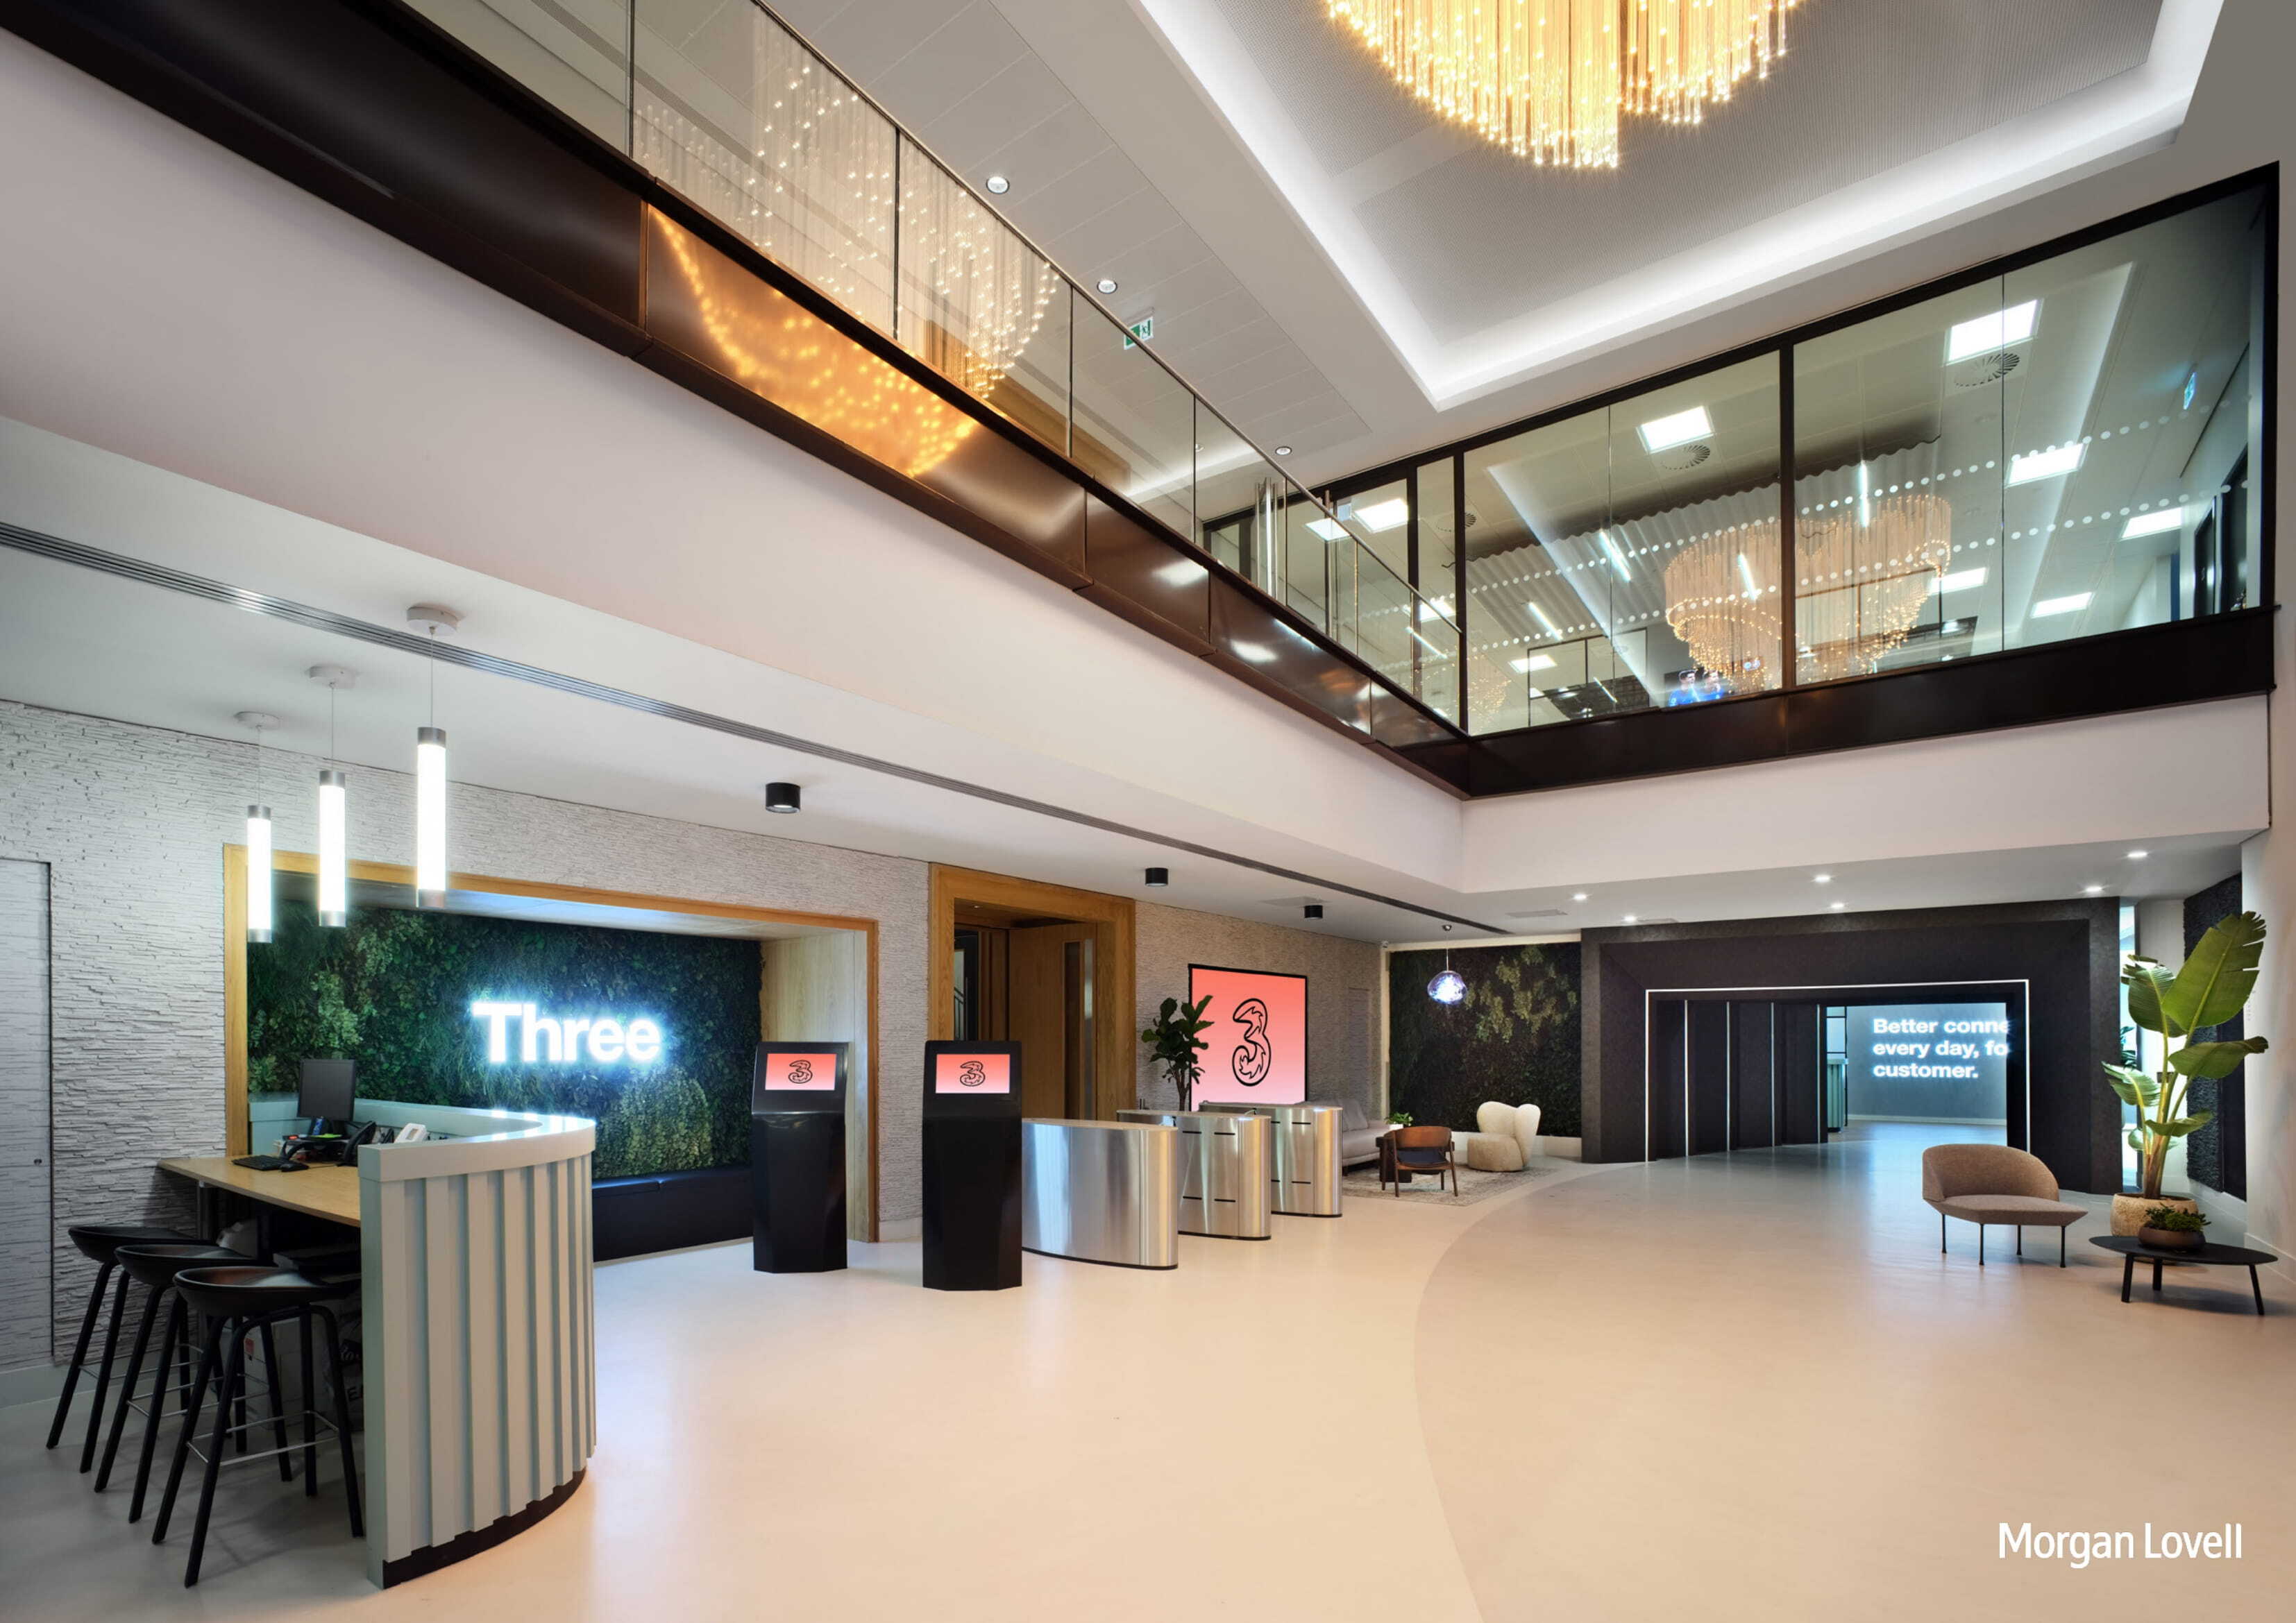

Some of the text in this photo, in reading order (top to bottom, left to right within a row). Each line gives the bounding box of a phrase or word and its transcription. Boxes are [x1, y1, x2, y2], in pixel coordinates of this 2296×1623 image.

[472, 1001, 661, 1063] Three
[1873, 1018, 1938, 1034] Better
[1231, 997, 1272, 1087] 3
[1873, 1044, 1930, 1059] every
[1935, 1040, 1980, 1059] day,
[788, 1060, 813, 1085] 3
[959, 1060, 986, 1087] 3
[1873, 1062, 1979, 1078] customer.
